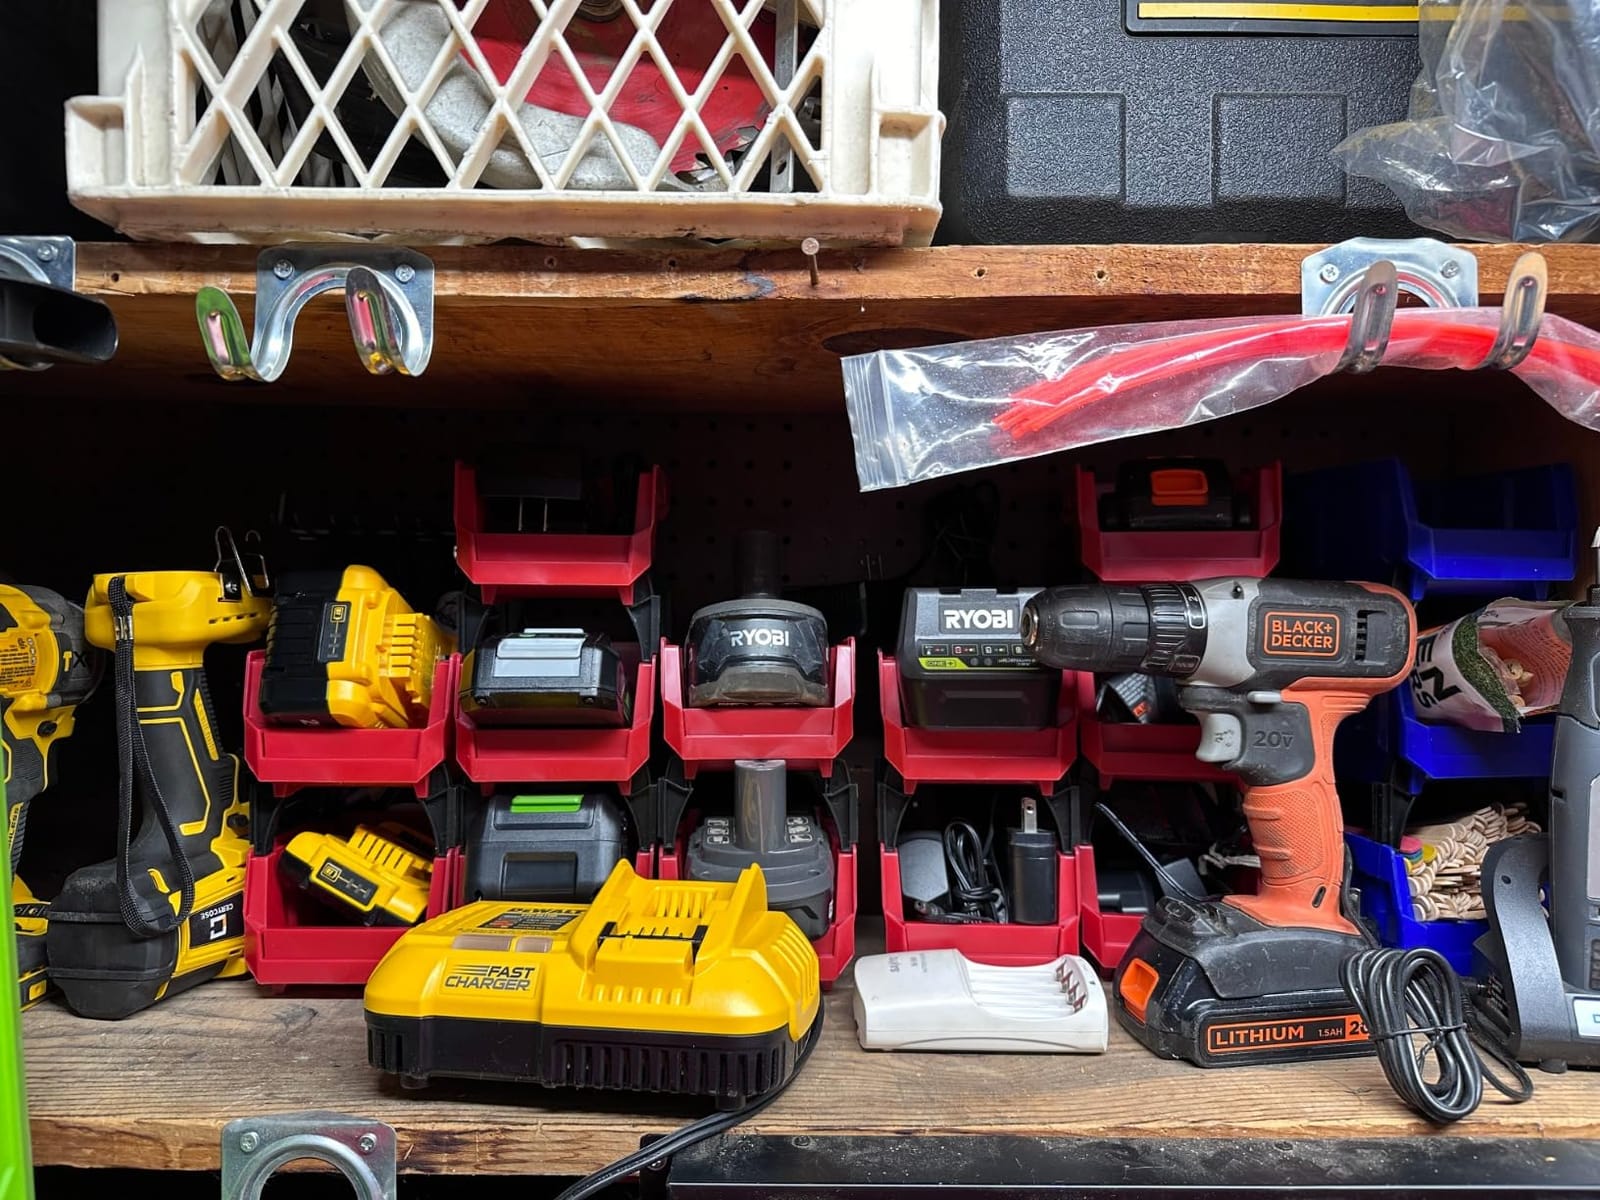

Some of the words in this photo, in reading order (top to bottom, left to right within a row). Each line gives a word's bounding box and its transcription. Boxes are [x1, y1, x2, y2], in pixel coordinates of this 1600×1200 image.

[943, 609, 1013, 629] RYOBI
[1271, 619, 1333, 634] BLACK+
[729, 628, 790, 647] RYOBI
[1271, 633, 1333, 648] DECKER
[487, 965, 535, 979] FAST
[444, 975, 531, 991] CHARGER
[1215, 1025, 1304, 1046] LITHIUM
[1318, 1027, 1343, 1038] 1.5AH
